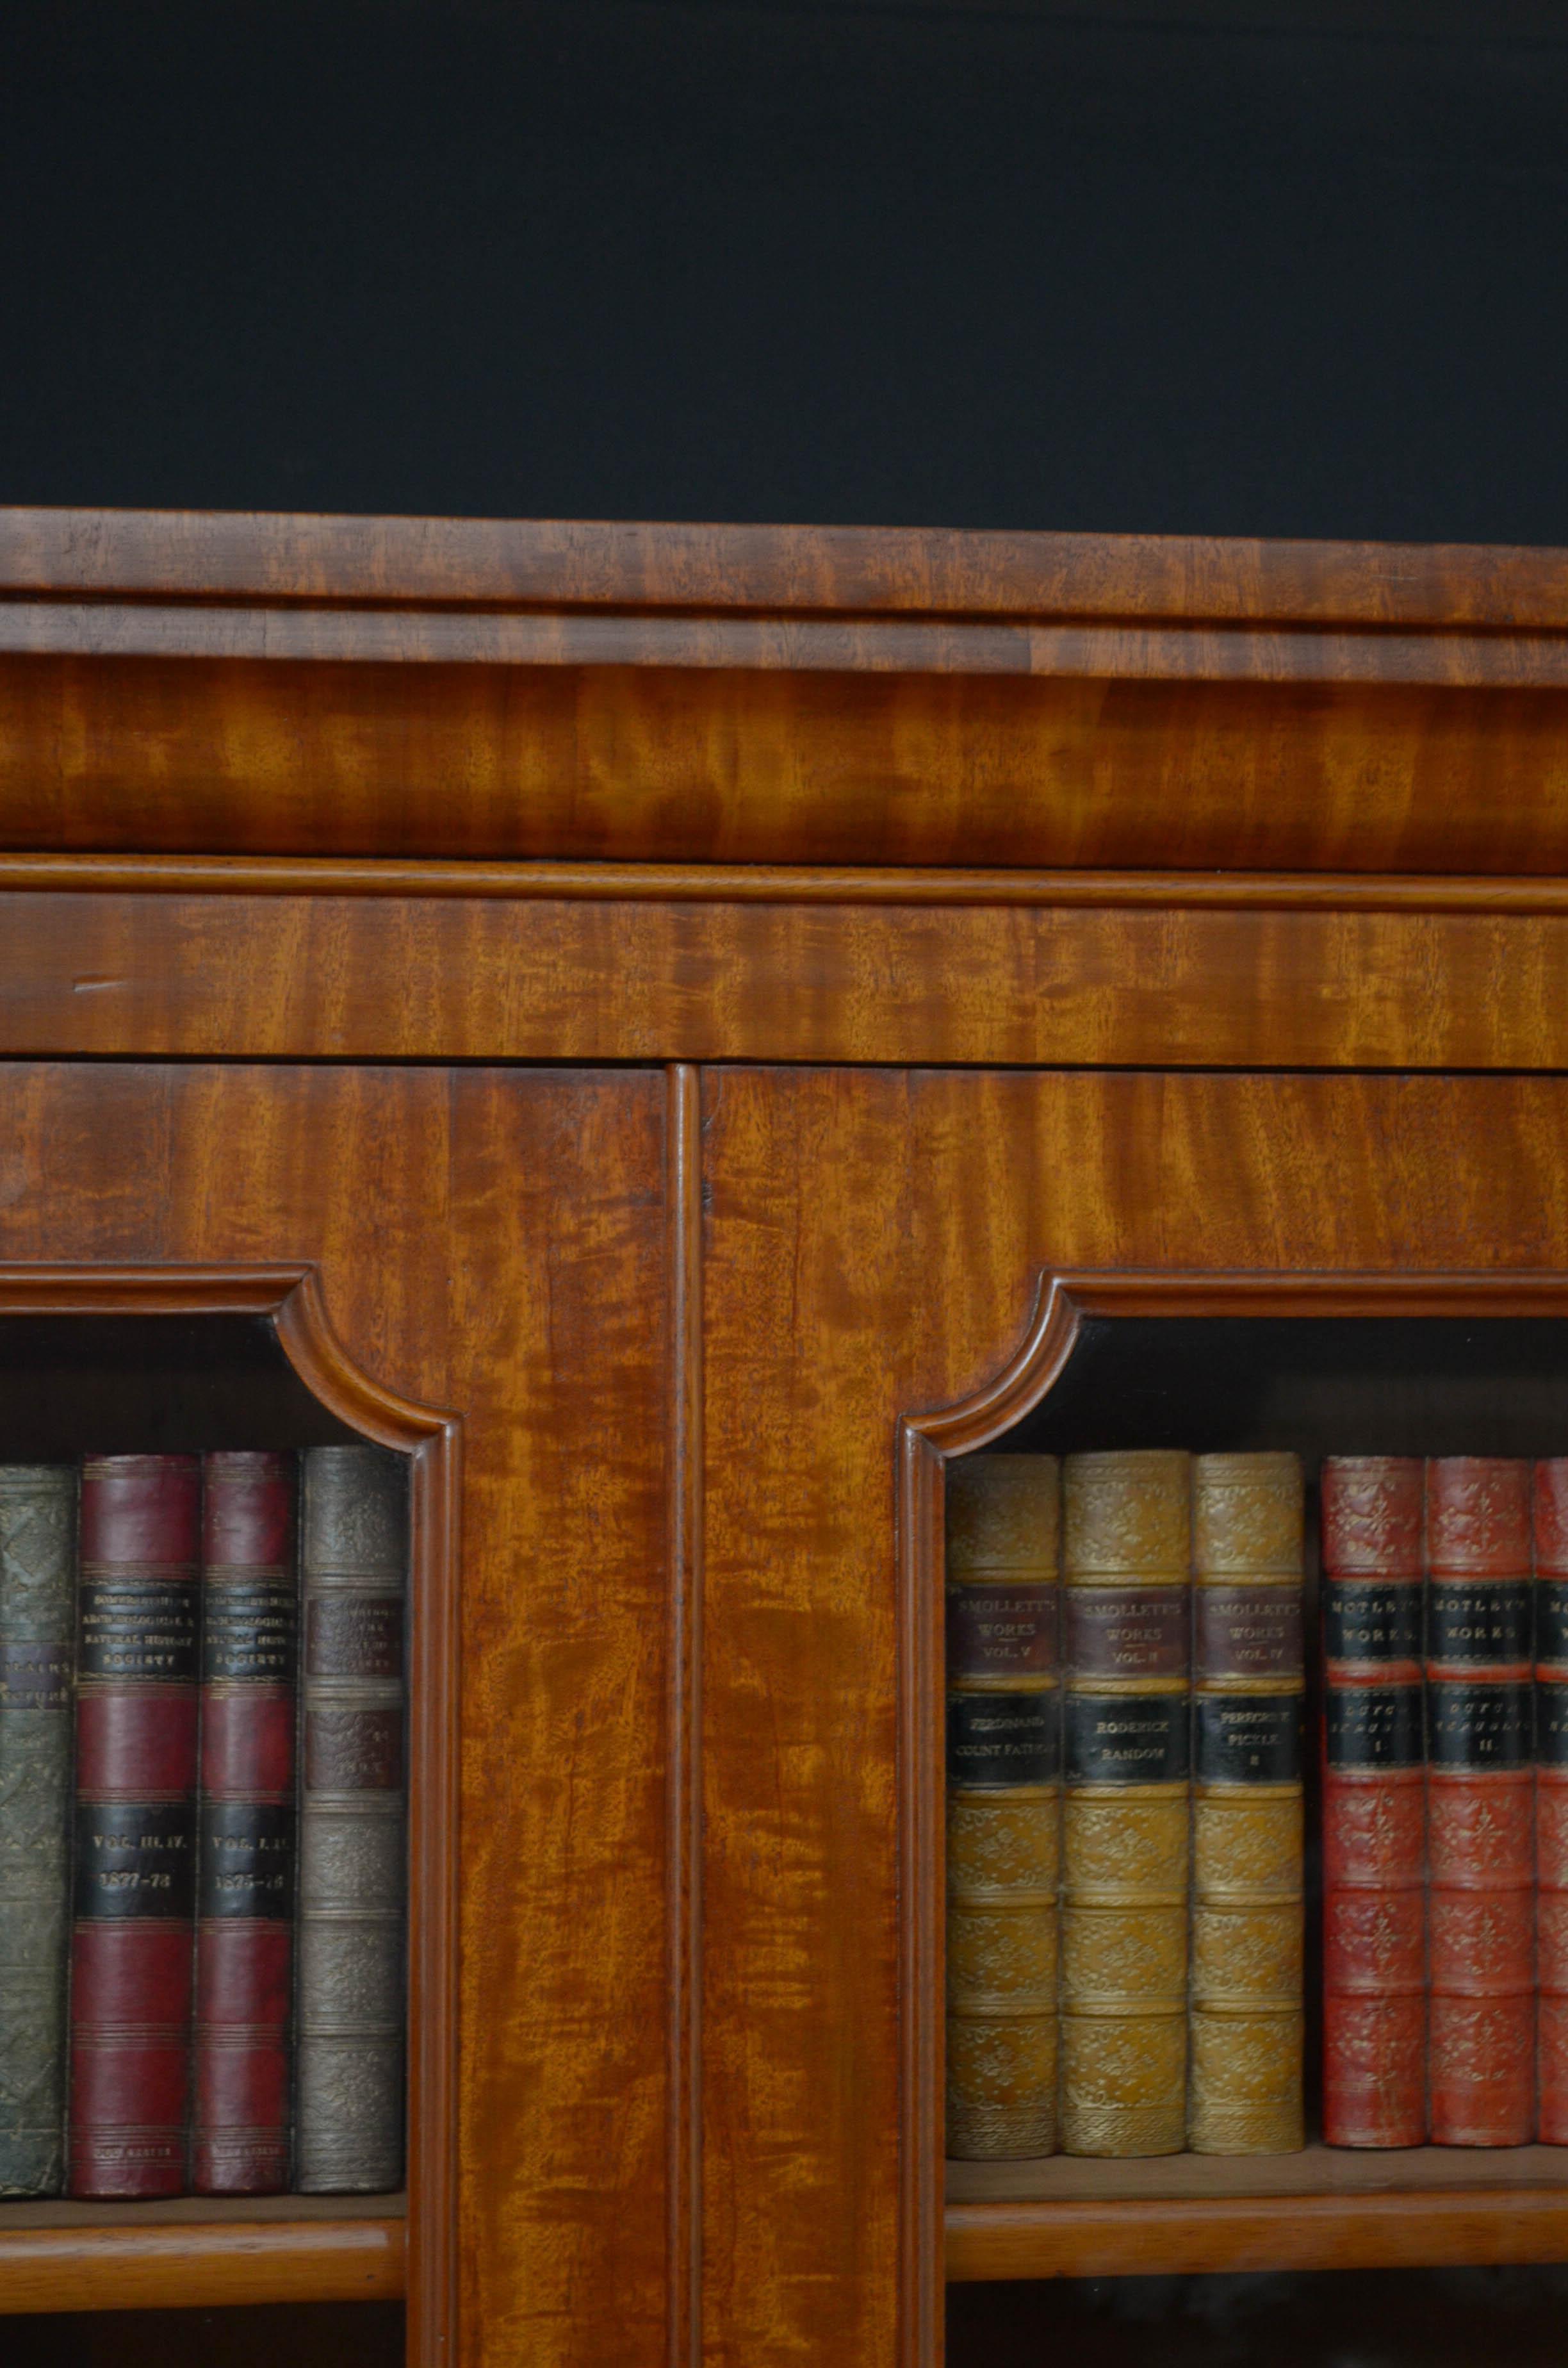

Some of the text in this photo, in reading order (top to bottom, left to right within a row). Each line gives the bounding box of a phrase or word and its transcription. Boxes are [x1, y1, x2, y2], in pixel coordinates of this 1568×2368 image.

[978, 1623, 1036, 1637] WORKS
[1106, 1627, 1162, 1641] WORKS
[1229, 1627, 1284, 1640] WORKS
[983, 1645, 1031, 1658] VOL. V
[1112, 1651, 1147, 1664] VOL.
[102, 1653, 176, 1667] SOCIETY
[1096, 1721, 1169, 1734] RODERICK
[955, 1744, 1002, 1757] COUNT
[1101, 1748, 1165, 1761] RANDOM
